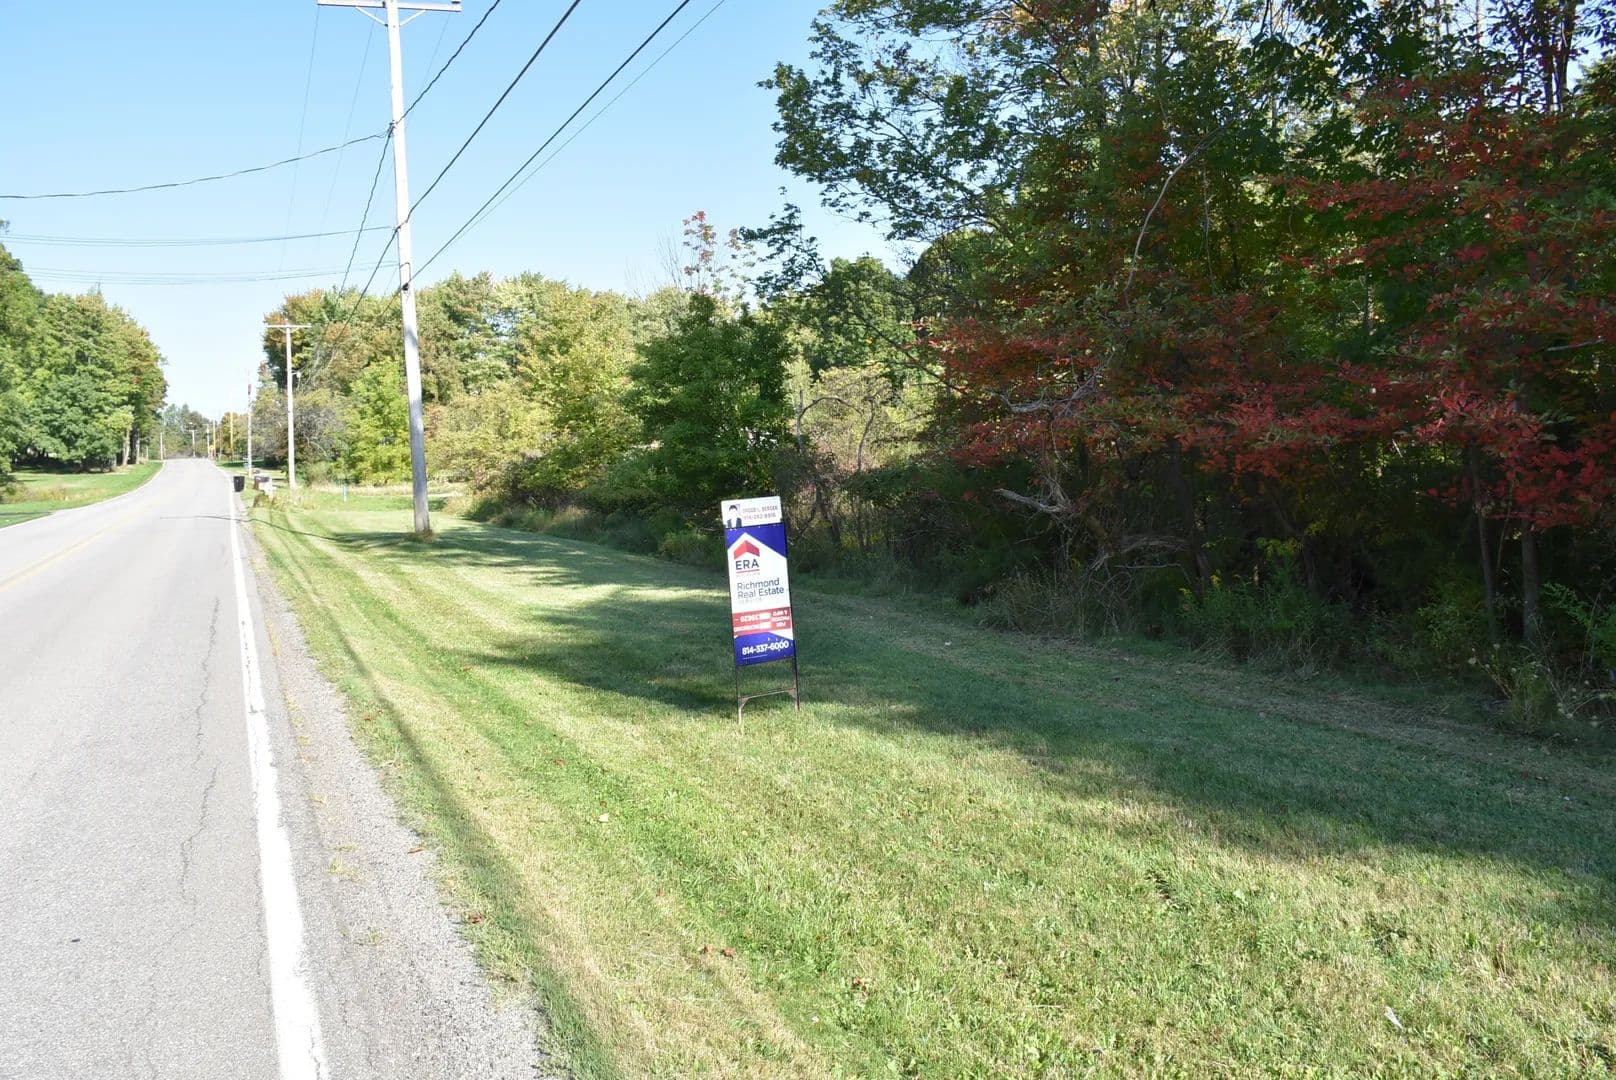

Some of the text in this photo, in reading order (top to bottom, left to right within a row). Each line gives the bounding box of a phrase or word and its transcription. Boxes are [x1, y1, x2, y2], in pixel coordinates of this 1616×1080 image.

[735, 558, 760, 571] ERA
[737, 577, 780, 591] Richmond
[737, 587, 785, 600] Real Estate
[742, 640, 789, 656] 814-337-6000
